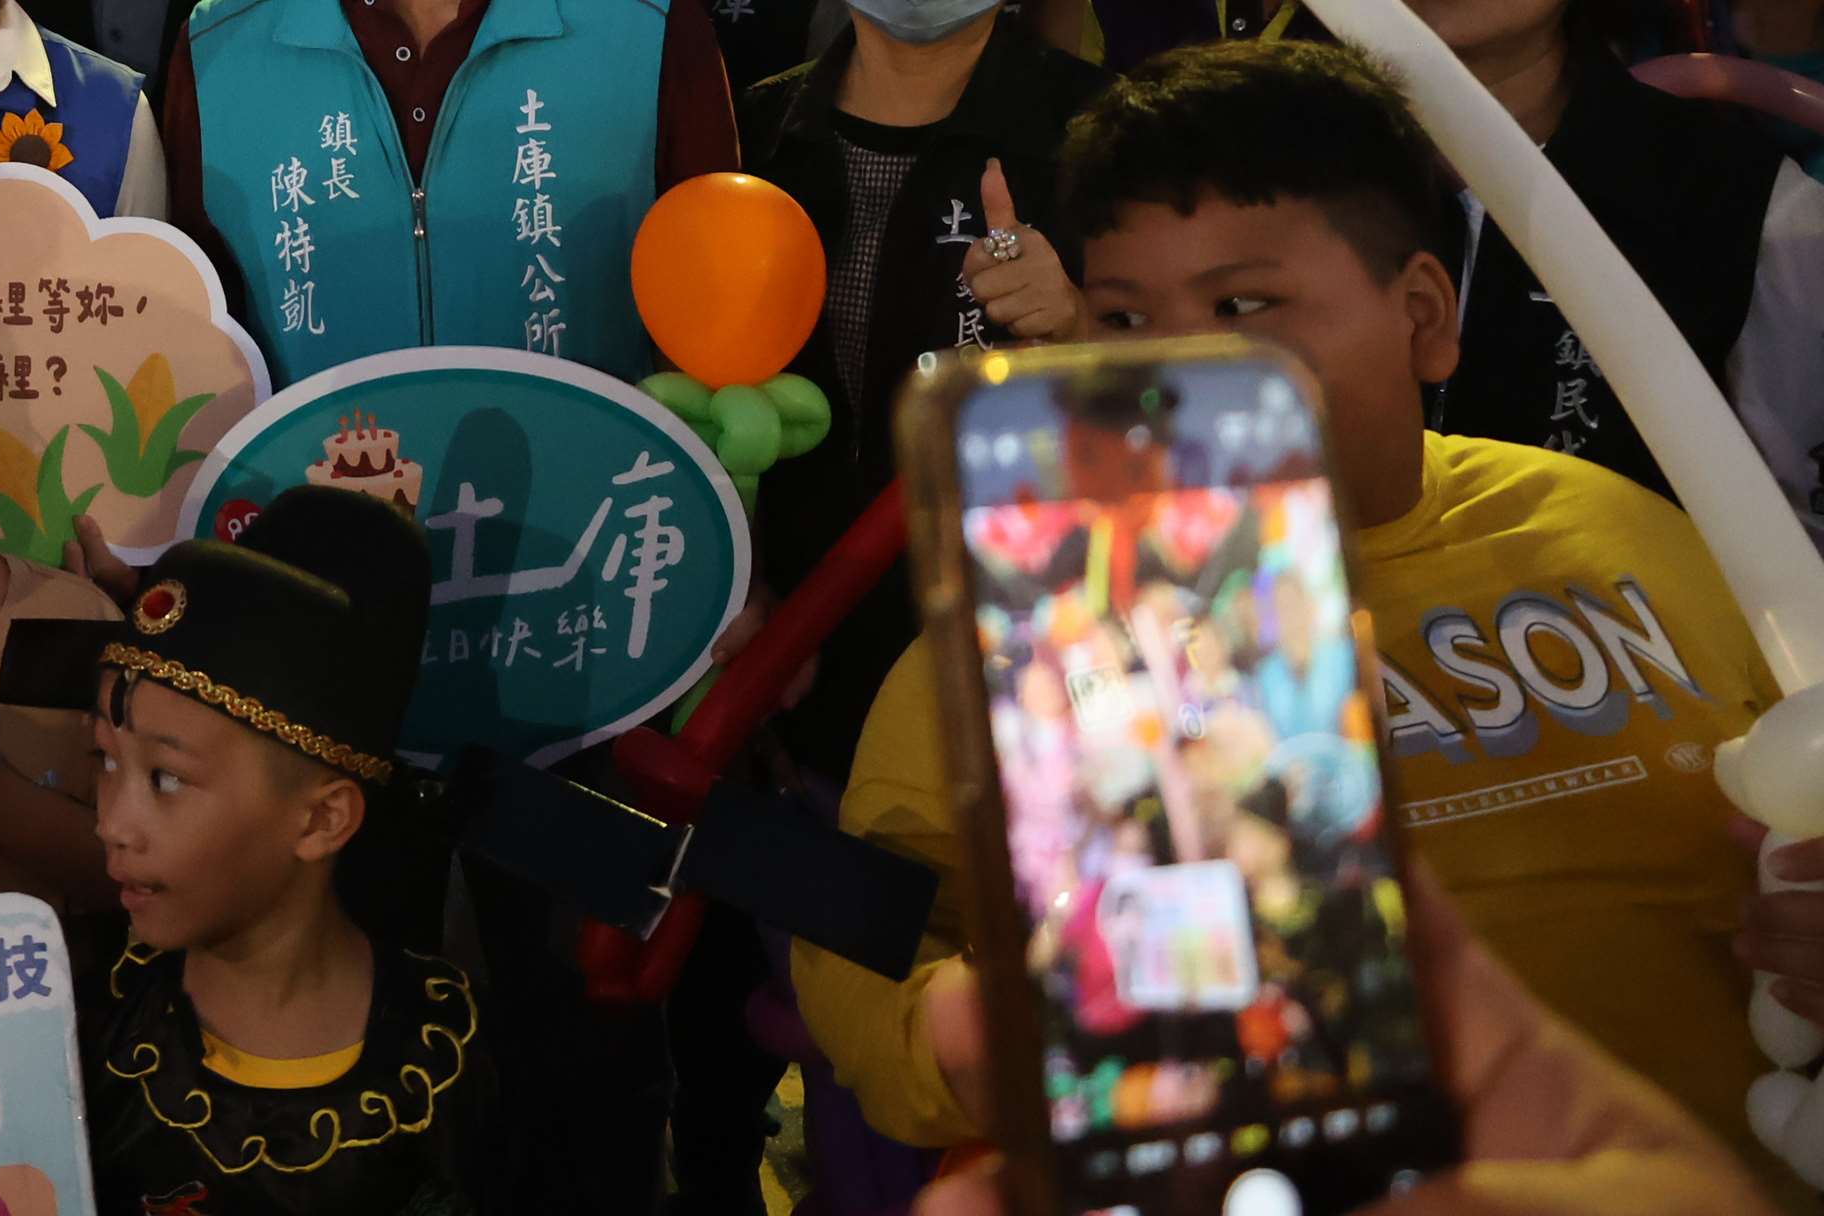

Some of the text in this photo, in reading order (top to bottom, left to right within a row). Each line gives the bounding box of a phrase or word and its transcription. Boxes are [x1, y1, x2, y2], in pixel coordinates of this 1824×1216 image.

[271, 156, 326, 335] 陳特凱
[318, 111, 360, 200] 鎮長
[512, 88, 567, 359] 土庫鎮公所
[425, 450, 685, 659] 土庫
